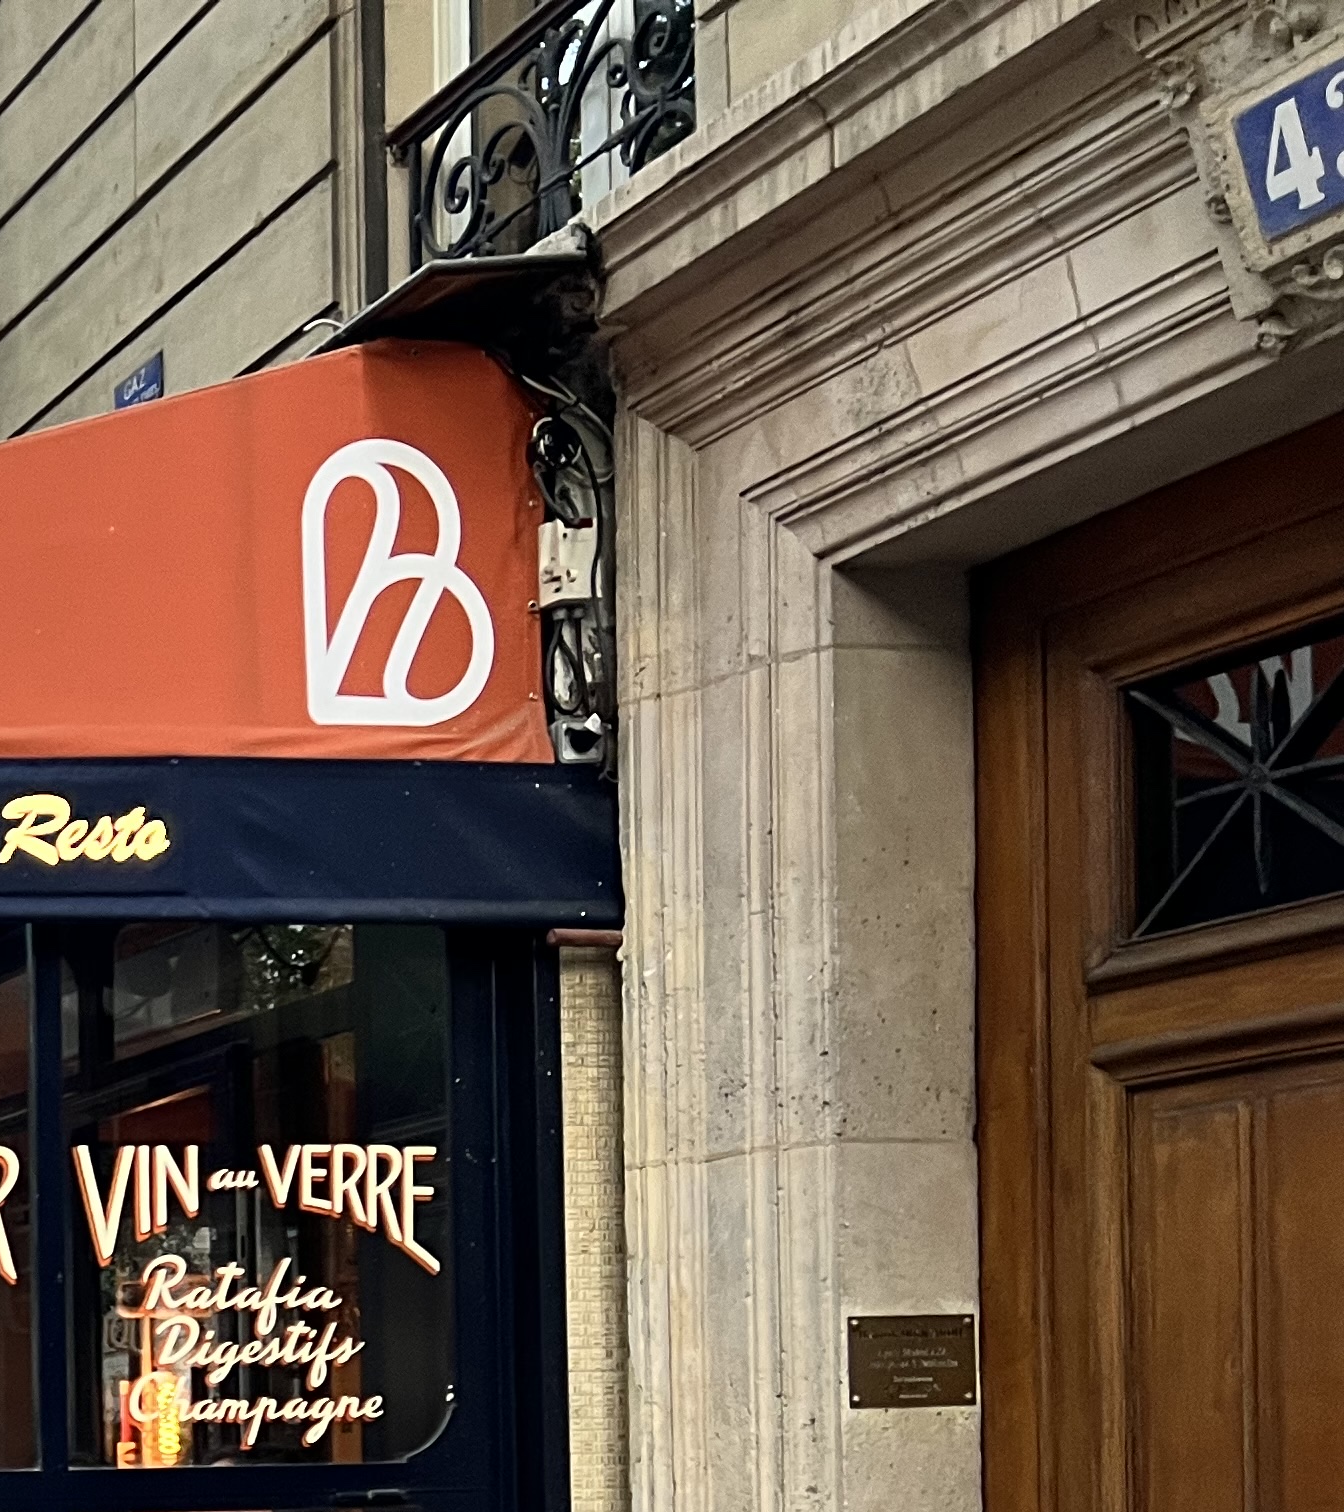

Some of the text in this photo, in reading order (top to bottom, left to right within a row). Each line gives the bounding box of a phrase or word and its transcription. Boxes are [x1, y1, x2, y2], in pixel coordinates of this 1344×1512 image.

[123, 367, 147, 401] GAZ
[72, 1143, 441, 1275] VIN au VERRE
[142, 1254, 343, 1337] Ratafia
[154, 1317, 366, 1390] Digestifs
[128, 1371, 385, 1450] Champagne
